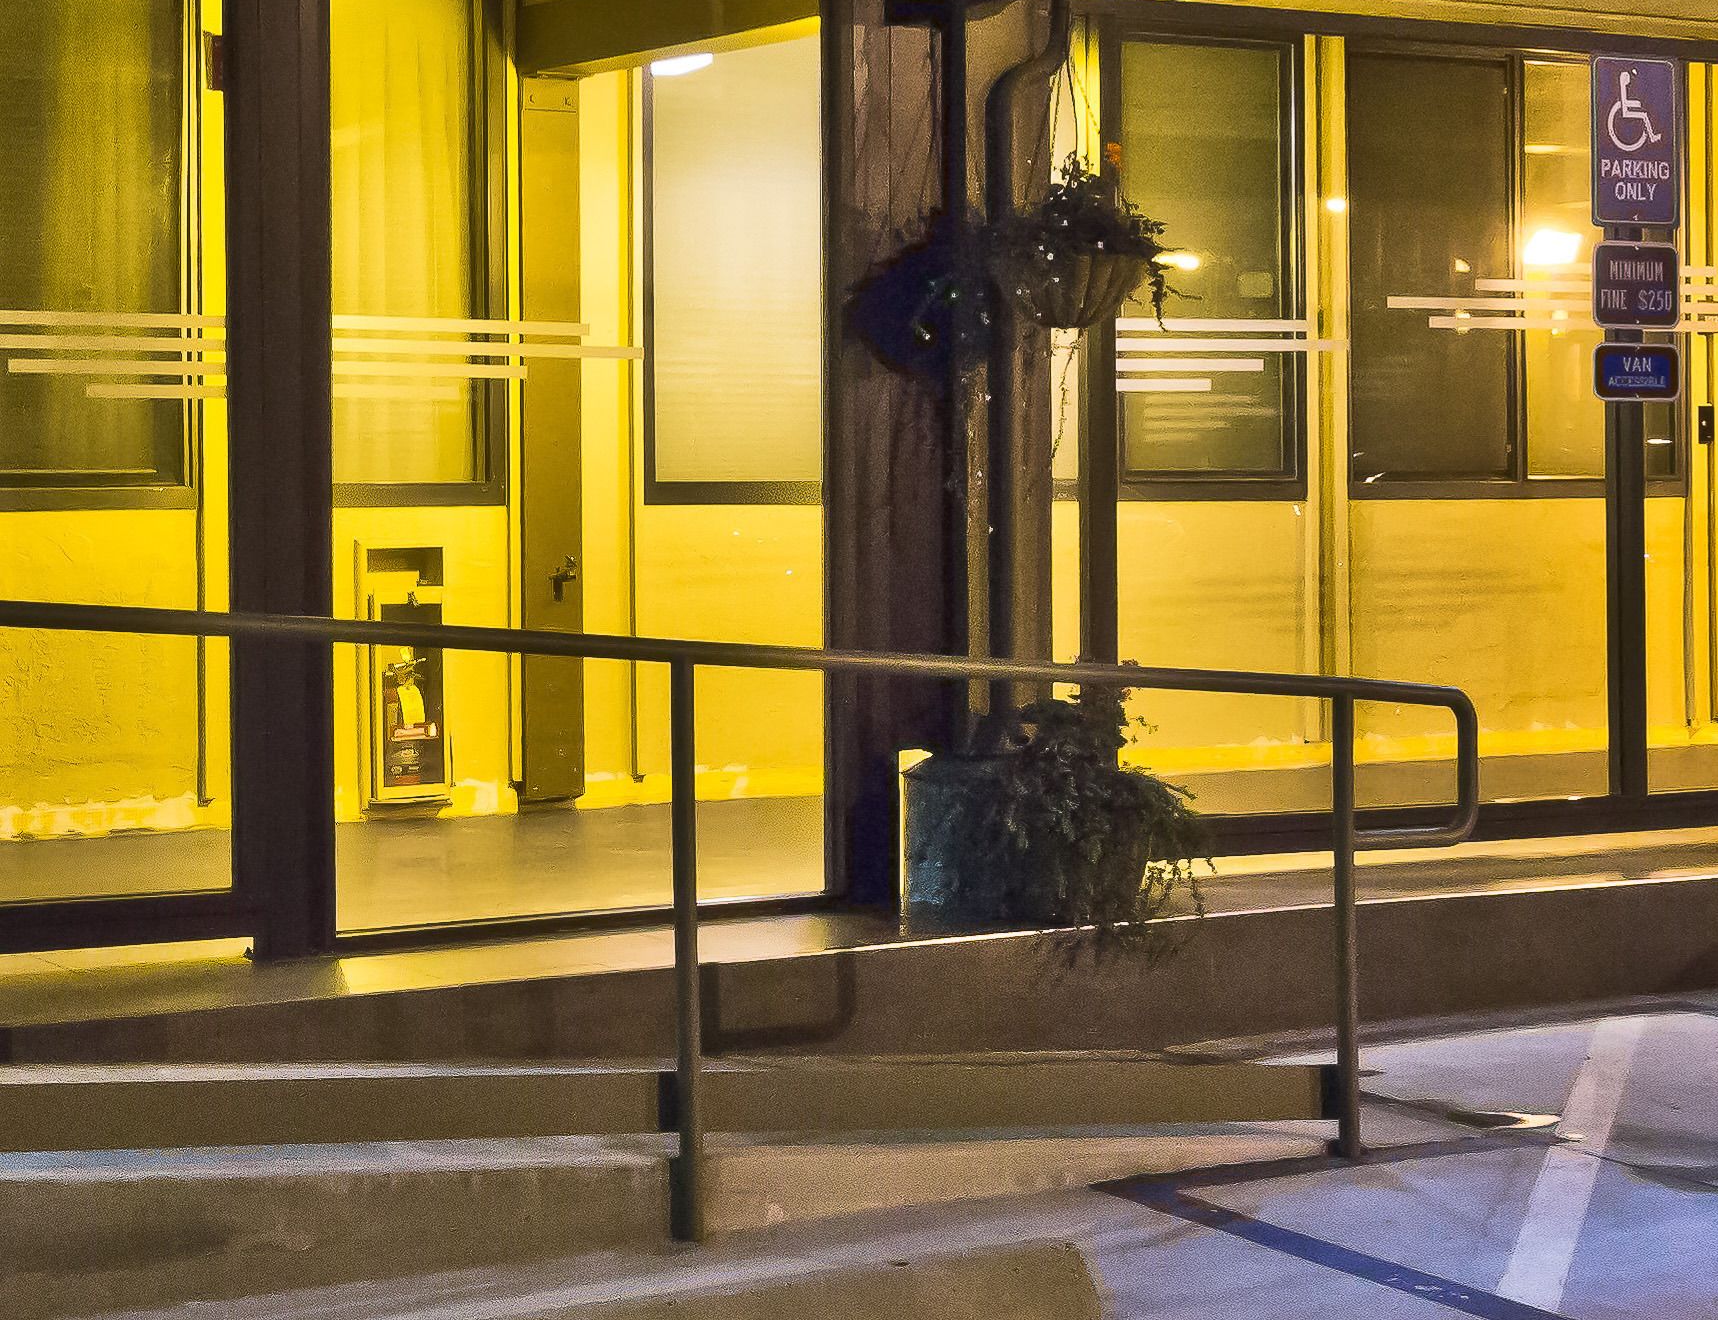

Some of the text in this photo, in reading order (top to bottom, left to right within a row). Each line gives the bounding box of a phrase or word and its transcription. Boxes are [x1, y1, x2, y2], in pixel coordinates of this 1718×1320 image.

[1601, 159, 1670, 180] PARKING
[1615, 182, 1657, 201] ONLY
[1610, 260, 1664, 282] MINIMUM
[1600, 288, 1673, 312] FINE $250
[1622, 357, 1652, 373] VAN
